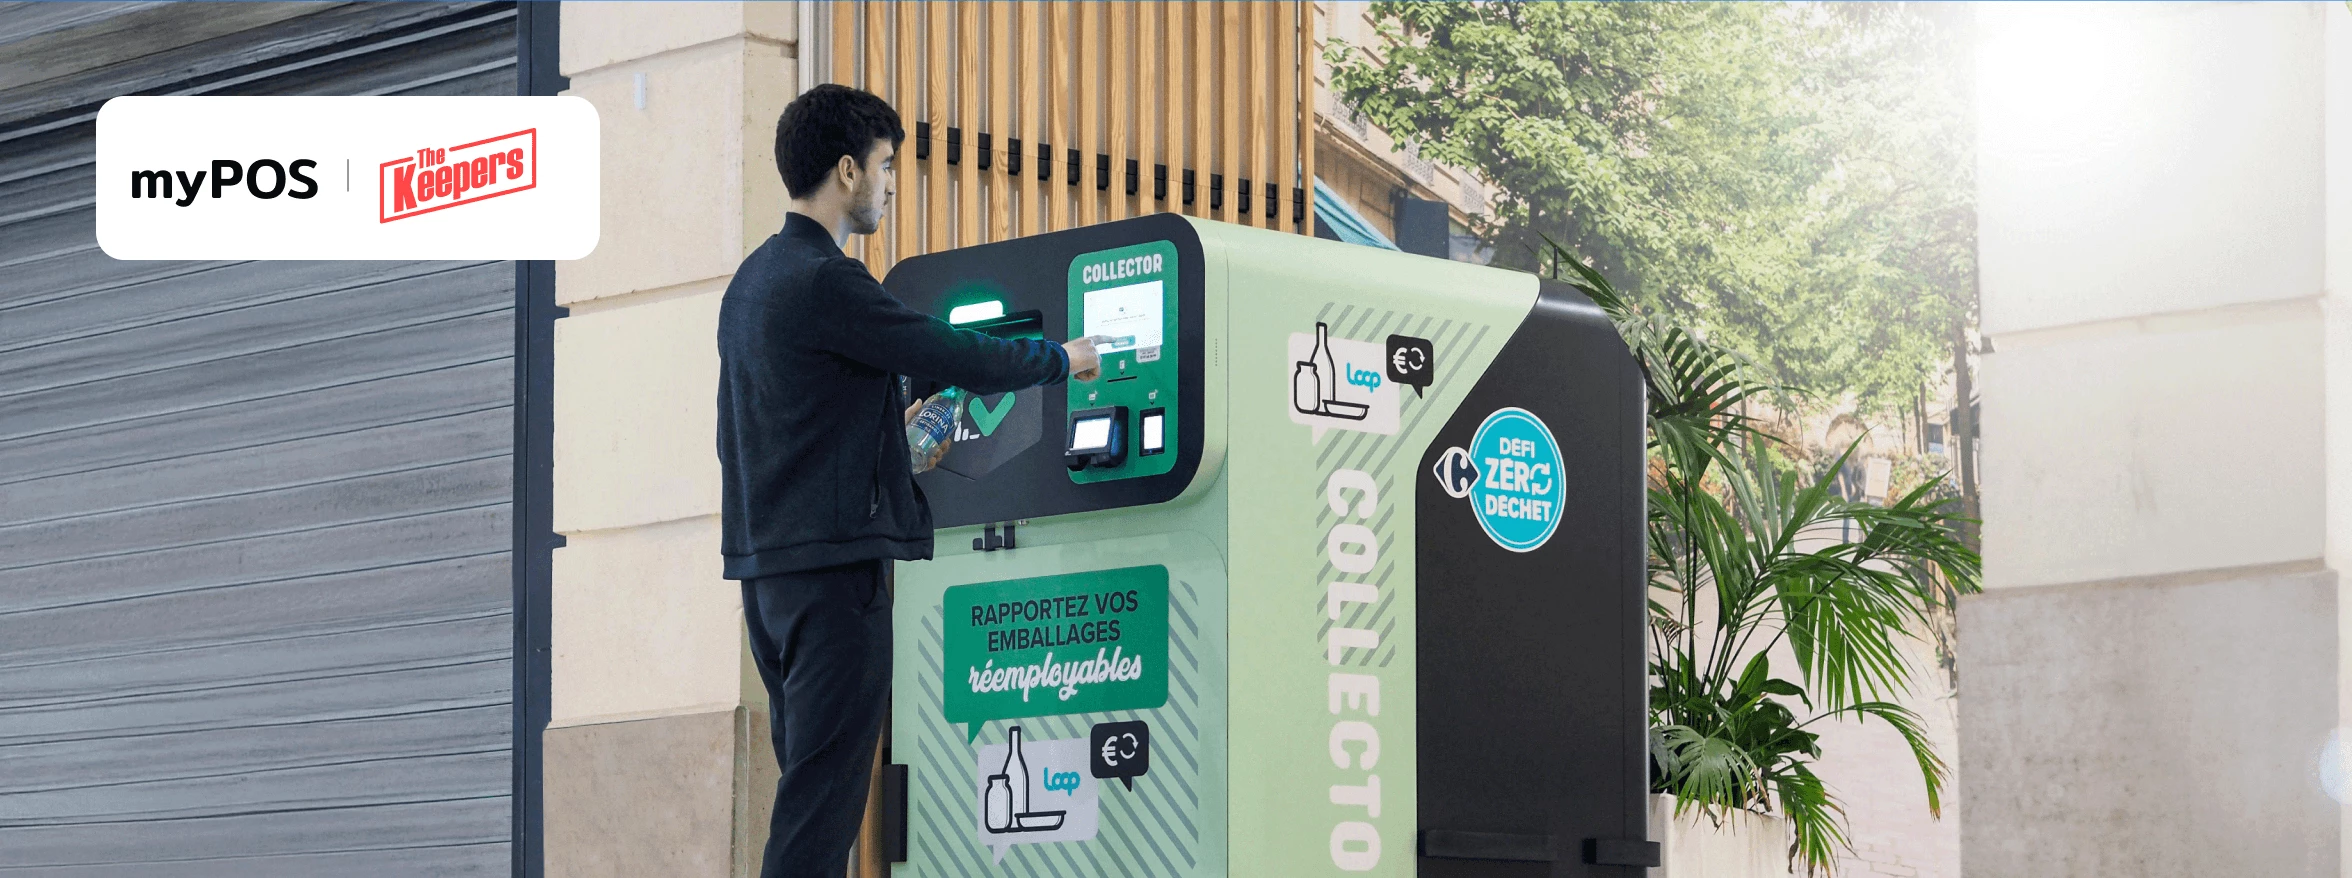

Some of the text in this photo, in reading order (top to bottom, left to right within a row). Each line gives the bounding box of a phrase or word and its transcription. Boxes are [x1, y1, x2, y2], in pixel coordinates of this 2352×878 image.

[1083, 253, 1163, 284] COLLECTOR
[919, 409, 949, 434] LORINA
[972, 590, 1139, 627] RAPPORTEZ VOS
[988, 619, 1121, 652] EMBALLAGES
[968, 646, 1142, 703] réemployables
[1327, 468, 1382, 872] COLLECTO
